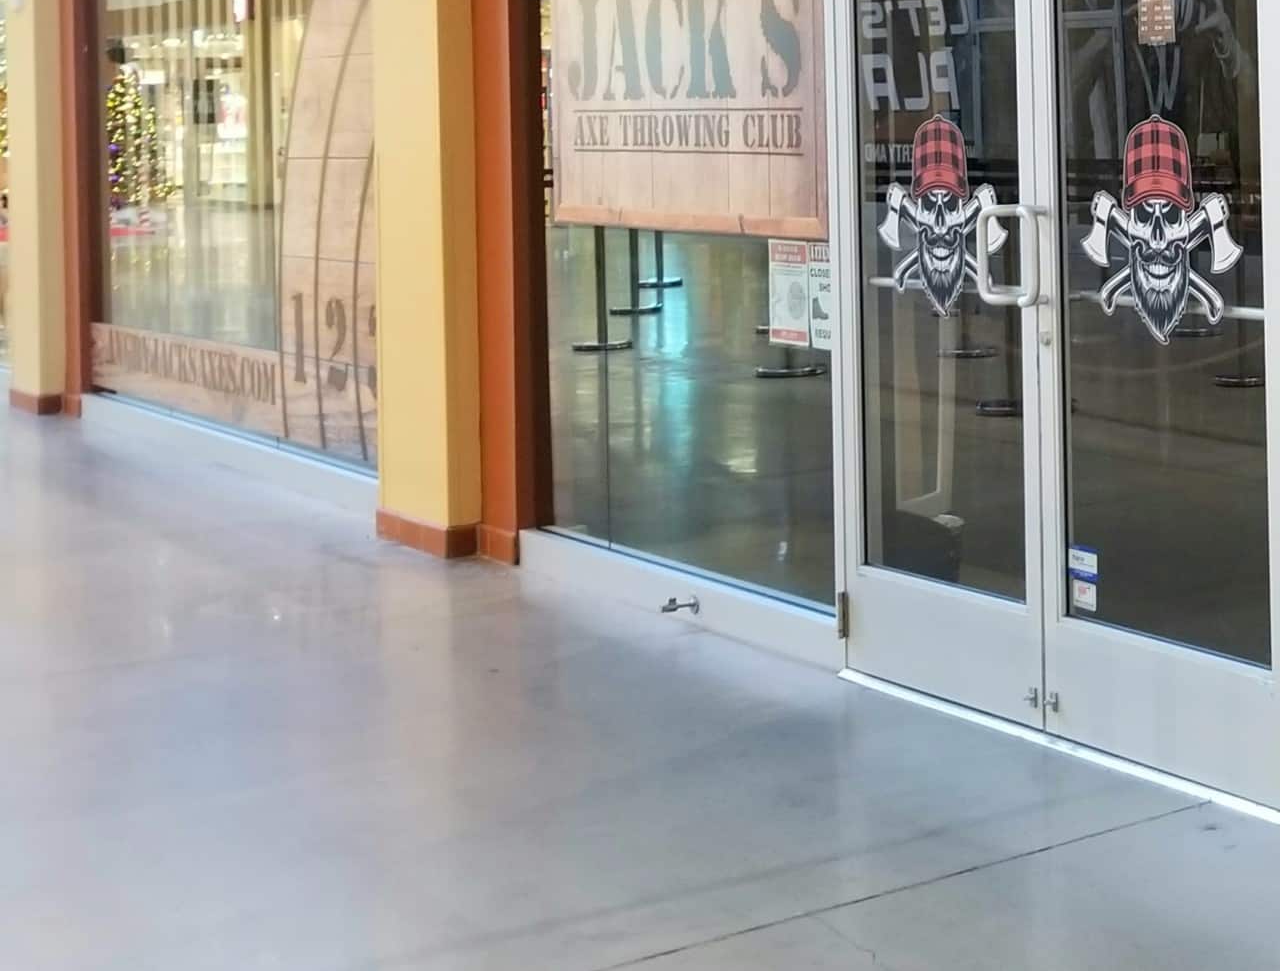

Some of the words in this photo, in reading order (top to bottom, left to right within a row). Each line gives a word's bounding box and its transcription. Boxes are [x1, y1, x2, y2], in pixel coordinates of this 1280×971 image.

[573, 114, 611, 148] AXE
[619, 112, 731, 149] THROWING
[741, 111, 803, 150] CLUB
